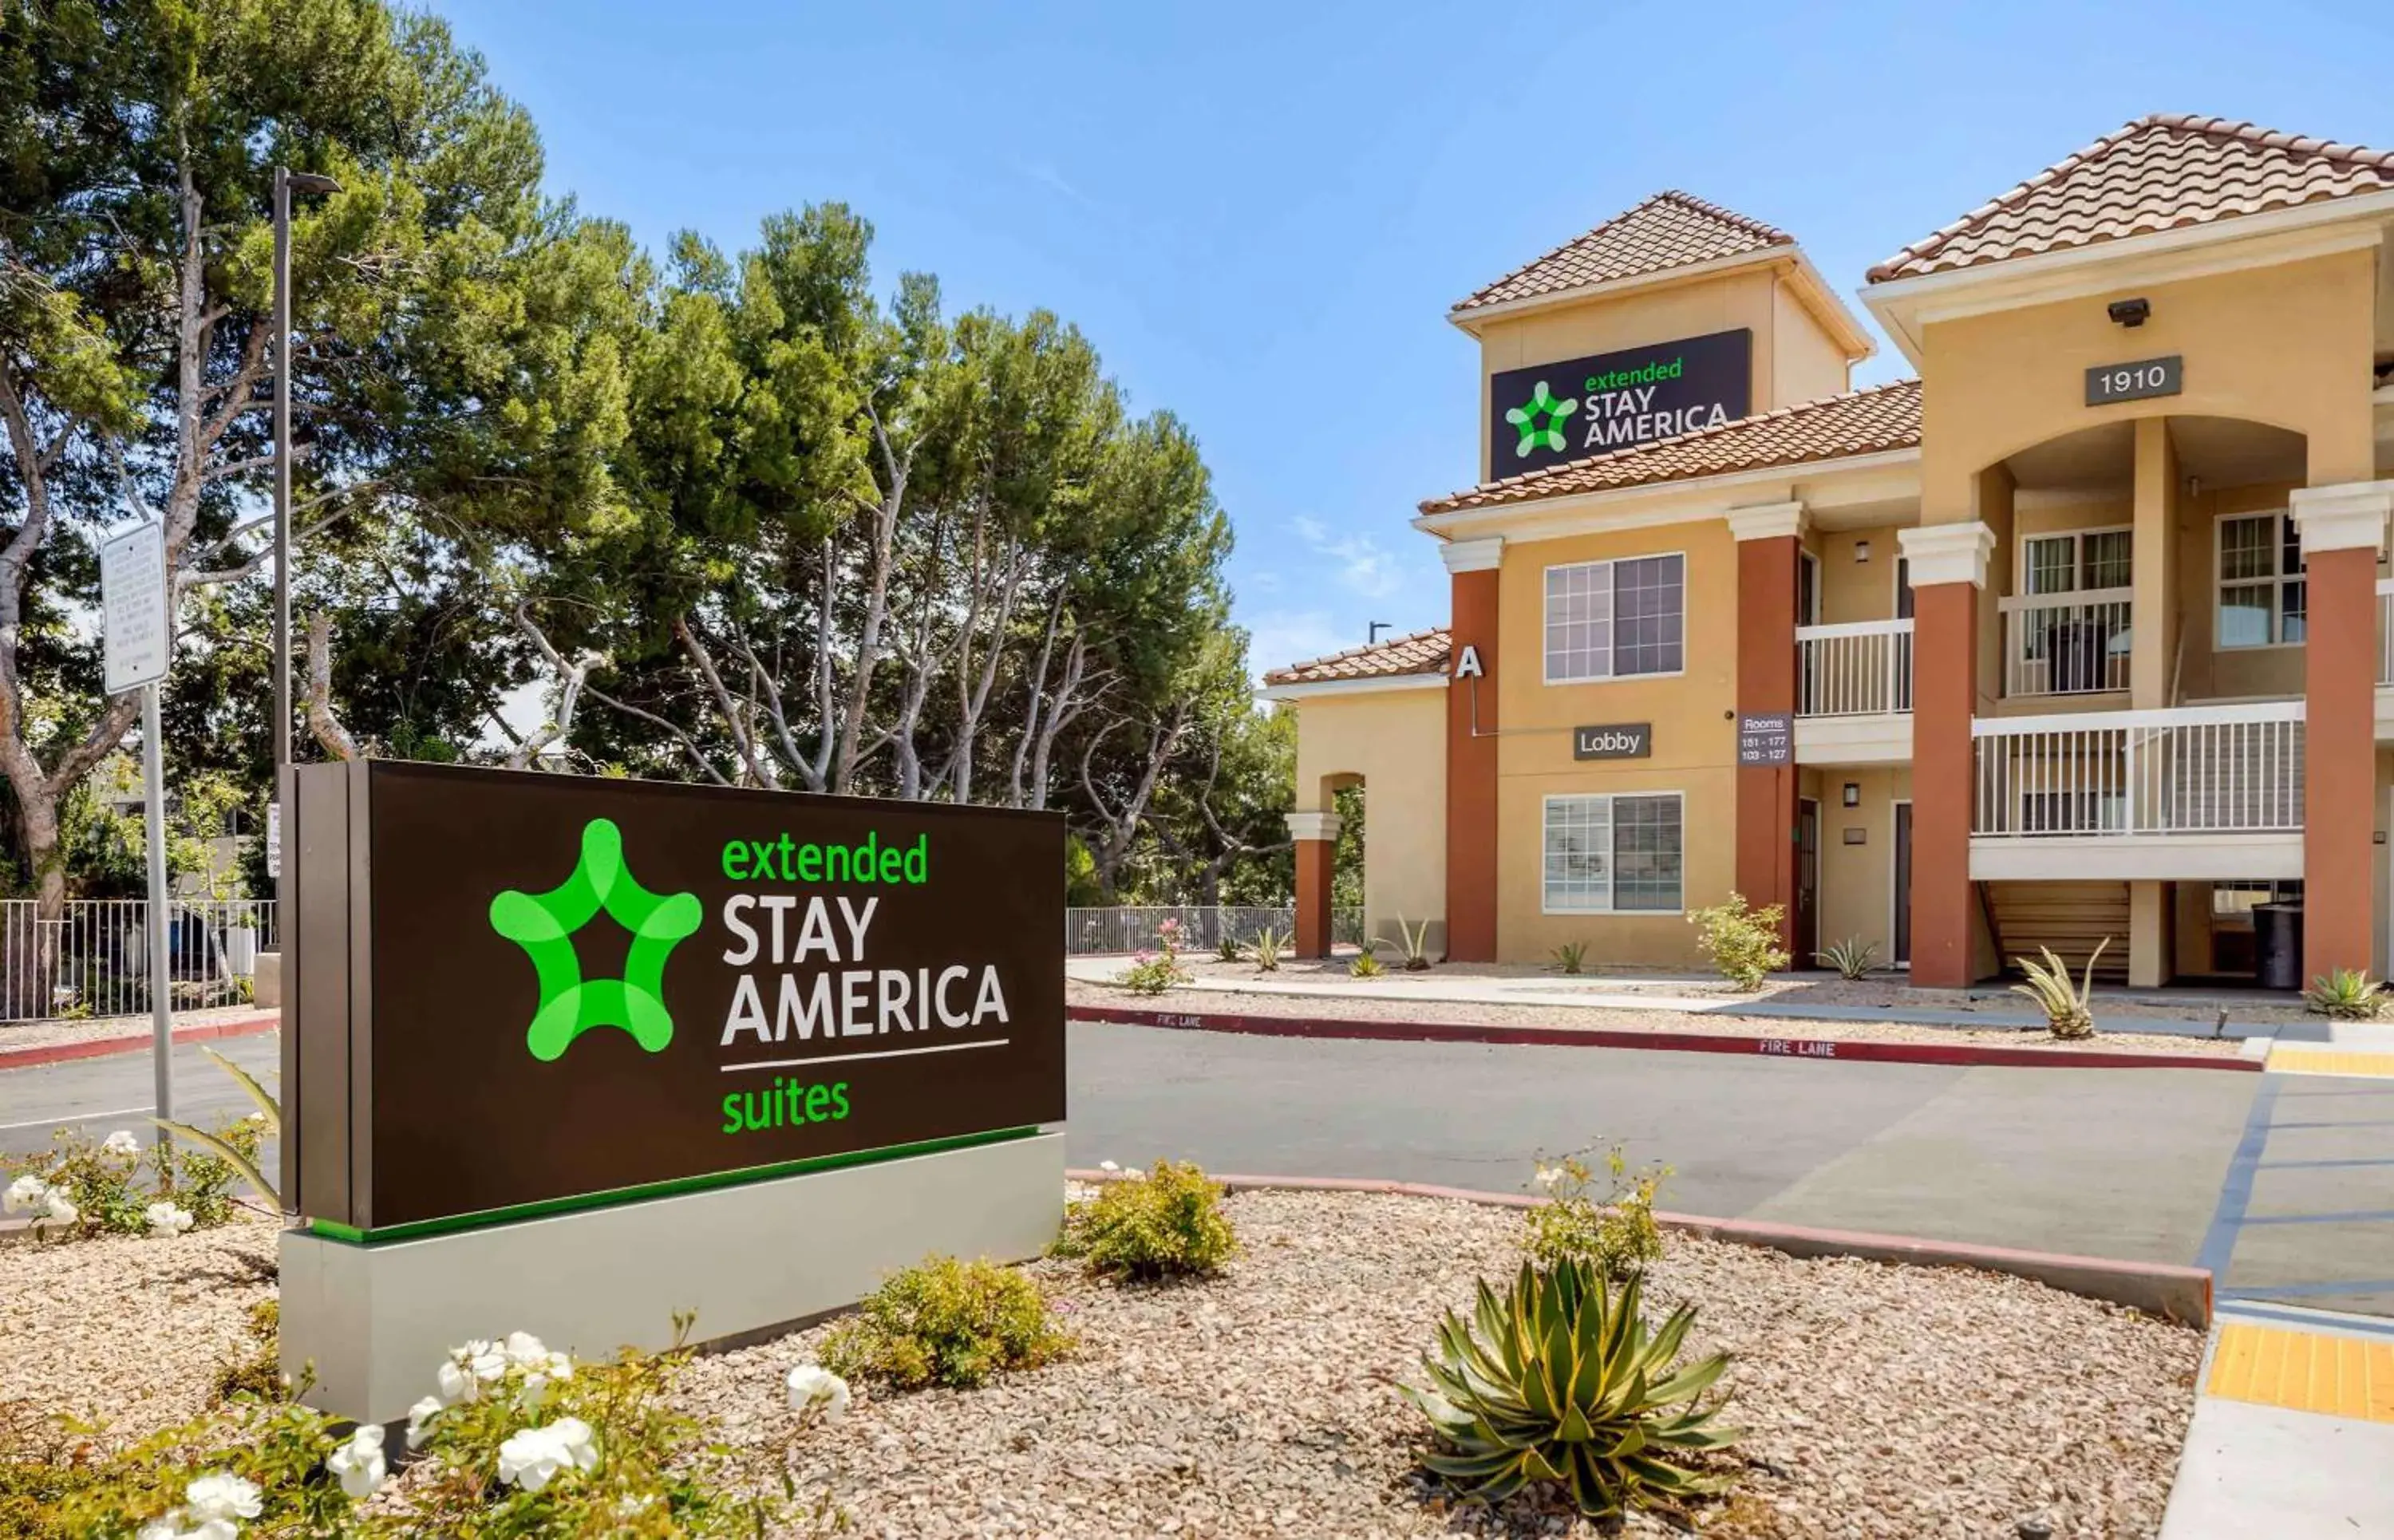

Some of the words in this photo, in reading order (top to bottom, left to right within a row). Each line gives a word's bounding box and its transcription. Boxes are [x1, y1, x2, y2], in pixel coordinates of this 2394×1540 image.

[1584, 357, 1683, 392] extended
[2100, 365, 2166, 394] 1910
[1584, 385, 1657, 421] STAY
[1583, 403, 1728, 448] AMERICA
[1455, 645, 1483, 678] A
[1744, 719, 1784, 730] Rooms
[1768, 736, 1786, 747] 177
[1580, 732, 1640, 754] Lobby
[1768, 750, 1786, 760] 127
[721, 830, 927, 884] extended
[722, 894, 879, 966] STAY
[720, 964, 1009, 1047] AMERICA
[1760, 1040, 1792, 1054] FIRE
[1798, 1041, 1835, 1057] LANE
[721, 1076, 850, 1135] suites
